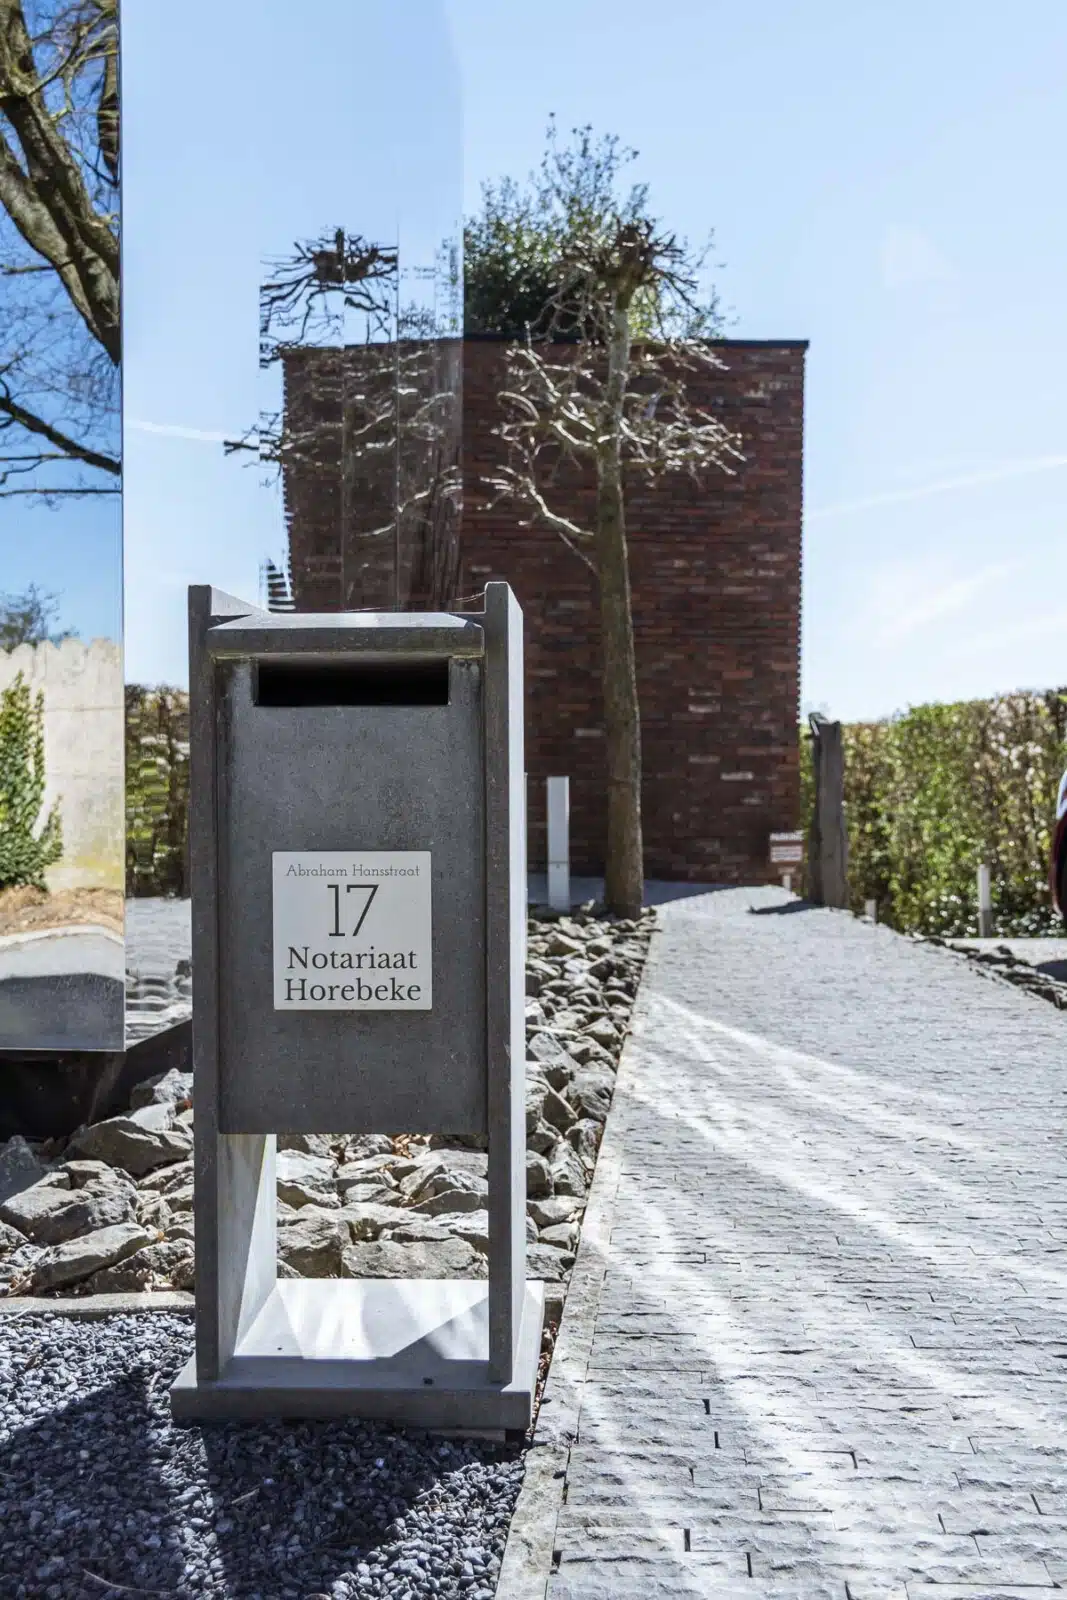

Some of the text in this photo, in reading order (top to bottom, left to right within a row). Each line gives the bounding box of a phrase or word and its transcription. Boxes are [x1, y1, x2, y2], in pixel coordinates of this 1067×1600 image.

[286, 864, 420, 877] Abraham Hansstraat
[327, 884, 379, 937] 17
[287, 946, 417, 969] Notariaat
[284, 977, 421, 1001] Horebeke
